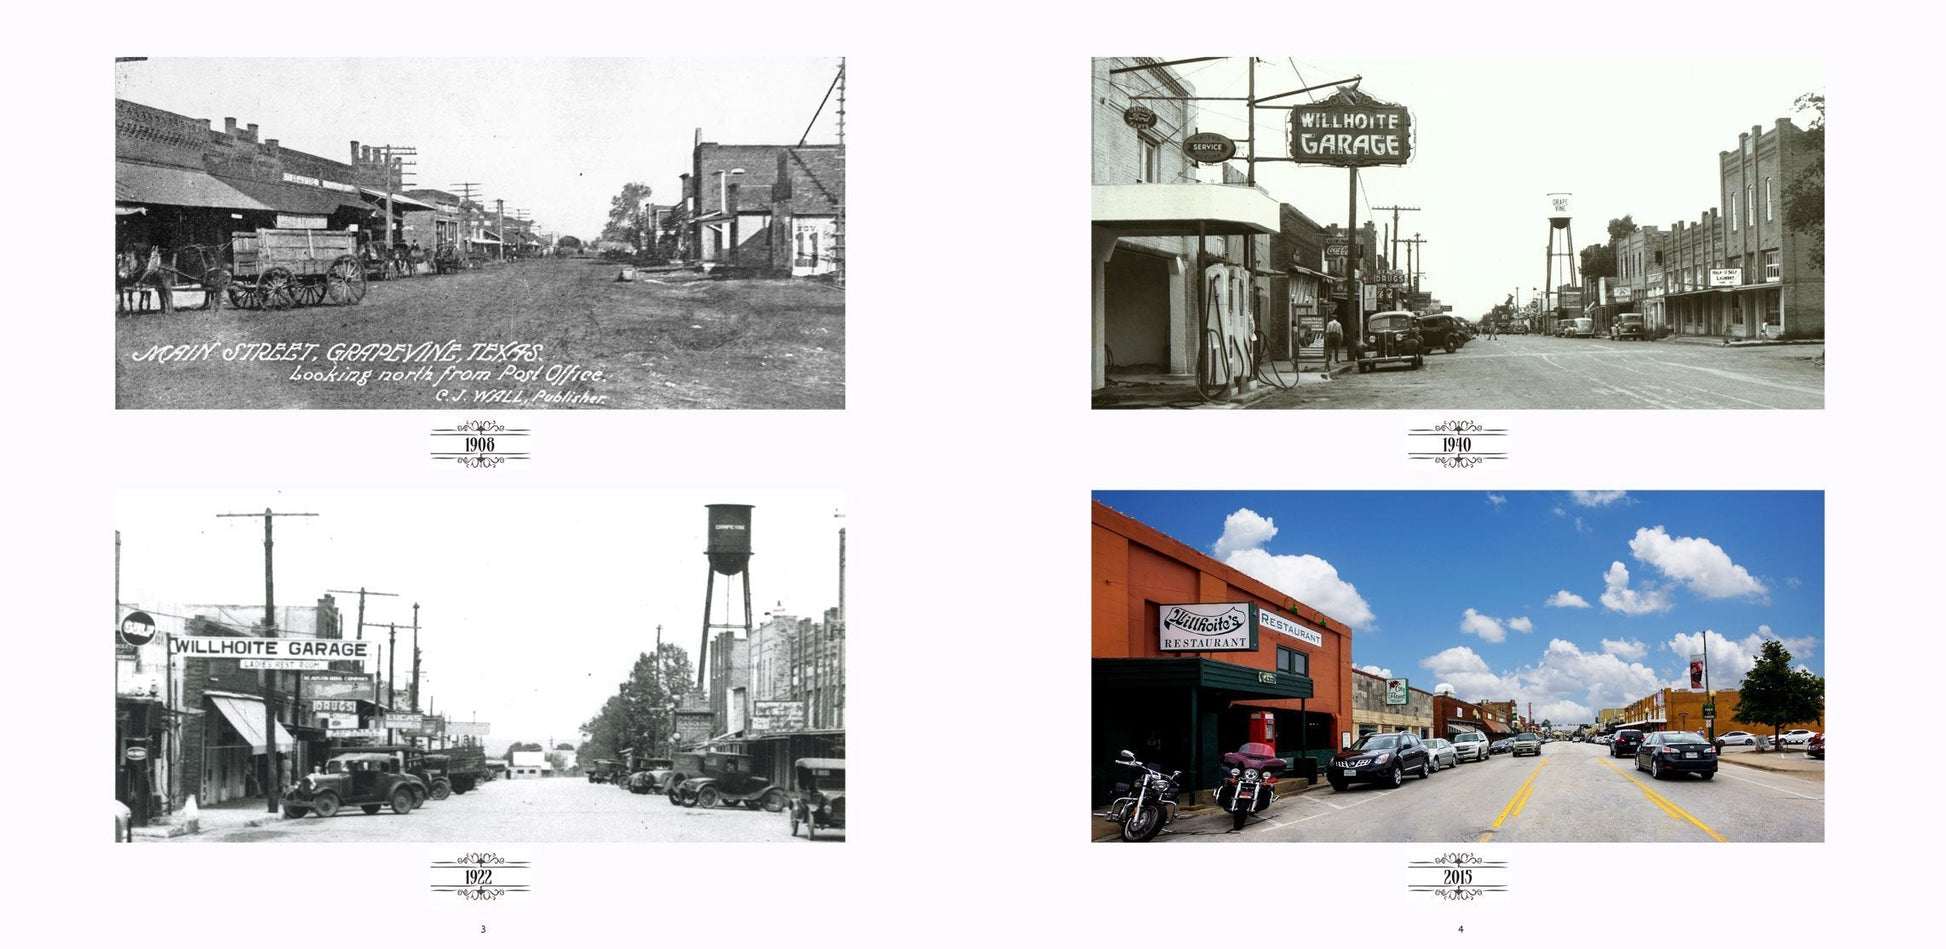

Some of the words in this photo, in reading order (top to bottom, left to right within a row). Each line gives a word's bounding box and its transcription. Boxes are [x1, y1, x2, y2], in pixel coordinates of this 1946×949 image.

[1300, 112, 1399, 129] WILLHOITE
[1193, 143, 1223, 151] SERVICE
[1301, 133, 1400, 156] GARAGE
[1552, 198, 1569, 206] GRAPE
[123, 619, 155, 638] GULF
[1169, 608, 1240, 632] Willhoite's
[1261, 612, 1321, 644] RESTAURANT
[174, 640, 278, 655] WILLHOITE
[288, 641, 367, 657] GARAGE
[1164, 637, 1247, 648] RESTAURANT
[275, 661, 294, 669] REST
[315, 700, 353, 711] DRUGS
